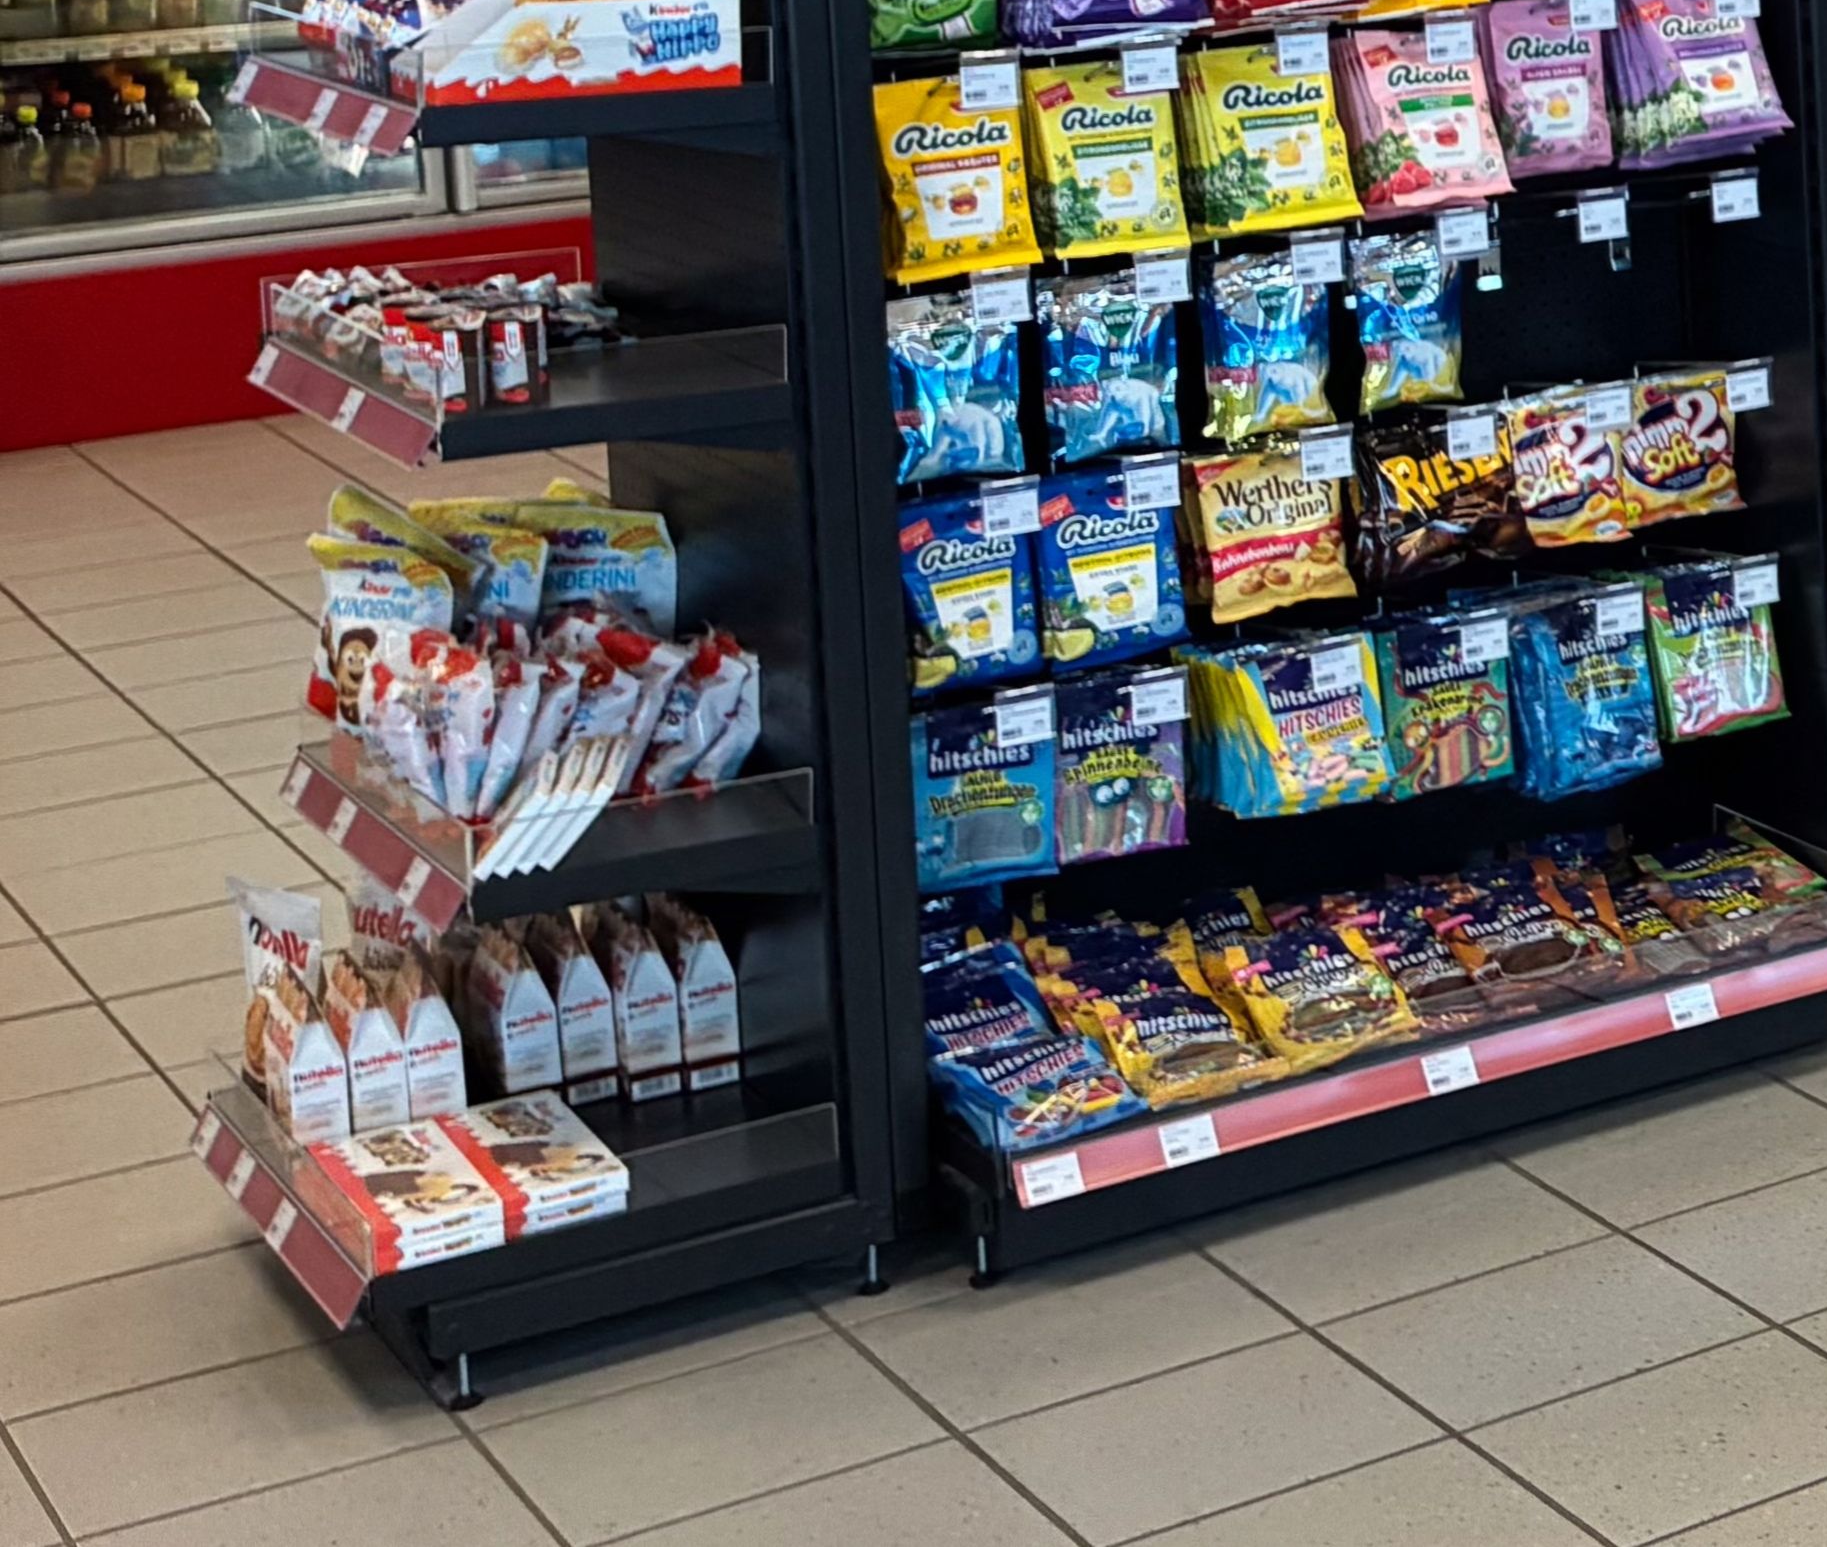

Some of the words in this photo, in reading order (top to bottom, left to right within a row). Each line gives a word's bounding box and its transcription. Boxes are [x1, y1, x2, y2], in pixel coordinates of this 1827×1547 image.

[1662, 16, 1740, 37] Ricola
[1507, 36, 1590, 60] Ricola
[1388, 65, 1471, 87] Ricola
[1223, 82, 1324, 110] Ricola
[1062, 105, 1153, 132] Ricola
[894, 121, 1009, 154] Ricola
[1104, 311, 1134, 326] WICK
[1676, 390, 1729, 452] 2
[1644, 434, 1700, 483] Soft
[1214, 476, 1333, 503] Werthers
[1246, 490, 1333, 527] Original
[1060, 513, 1154, 546] Ricola
[920, 536, 1013, 570] Ricola
[1558, 632, 1628, 658] hitschies
[1404, 661, 1486, 686] hitschies
[1278, 697, 1362, 738] HITSCHIES
[1062, 721, 1158, 750] hitschies
[929, 744, 1030, 774] hitschies
[353, 905, 418, 946] utella
[1263, 952, 1355, 988] hitschies
[1387, 944, 1449, 972] hitsch
[925, 1002, 1021, 1033] hitschies
